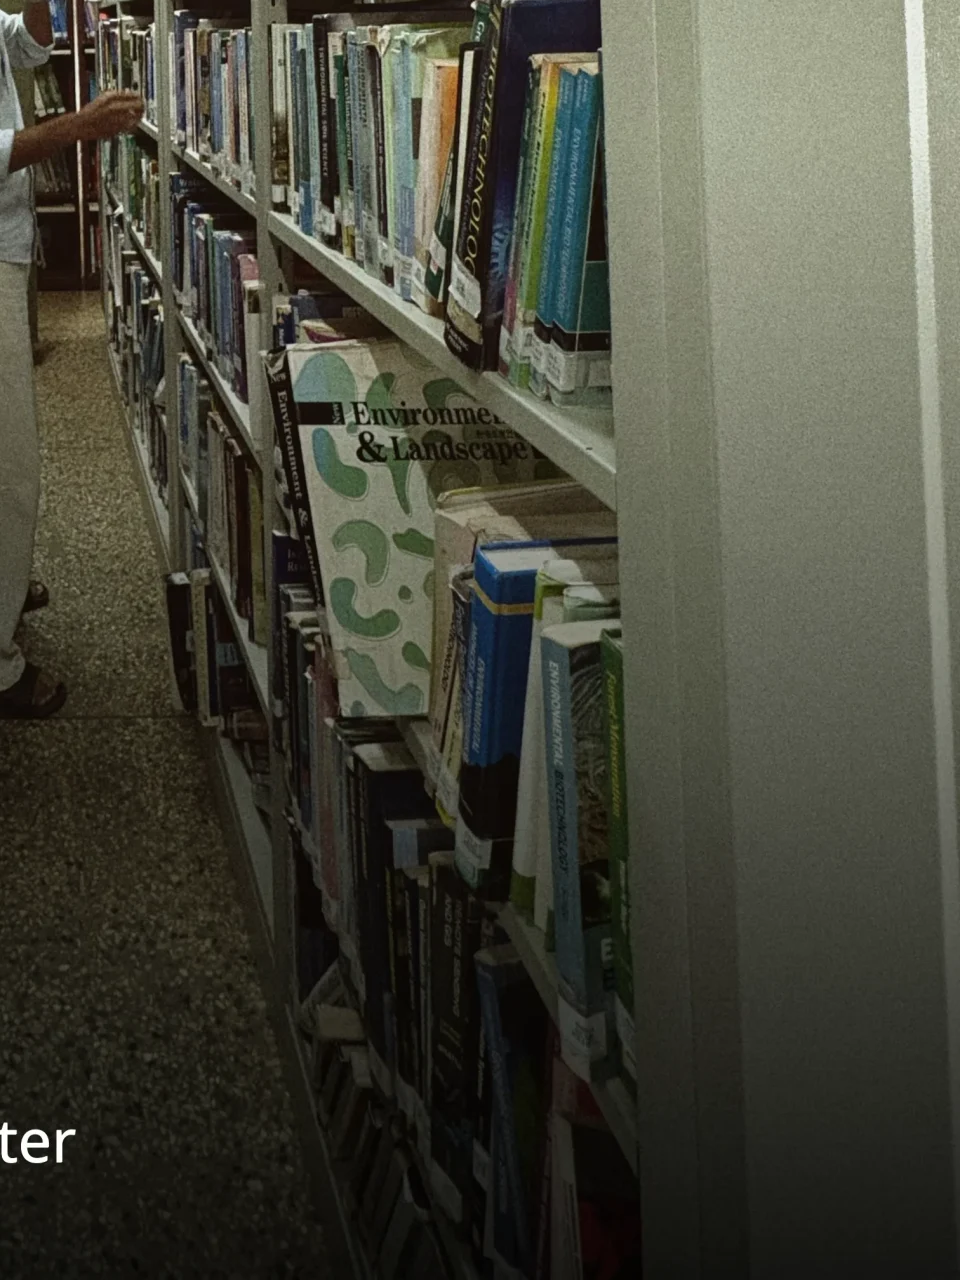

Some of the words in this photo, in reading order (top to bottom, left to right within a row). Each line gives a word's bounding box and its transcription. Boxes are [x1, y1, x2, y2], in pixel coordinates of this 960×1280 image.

[477, 20, 486, 43] Gre
[318, 47, 328, 117] ENVIRONMENTAL
[321, 142, 329, 178] SCIENCE
[464, 46, 499, 274] BIOTECHNOLOG
[563, 127, 581, 224] ENVIRONMENTAL
[276, 390, 303, 499] Environment
[298, 507, 309, 527] &
[356, 431, 387, 463] &
[391, 434, 528, 466] Landscape
[472, 657, 485, 754] ENVIRONMENTAL
[549, 660, 564, 767] ENVIRONMENTAL
[605, 671, 618, 719] Forest
[608, 721, 622, 818] Mensuration
[554, 769, 569, 874] BIOTECHNOLOGY
[444, 893, 453, 922] AND
[444, 923, 453, 947] GIS
[453, 899, 462, 955] REMOTE
